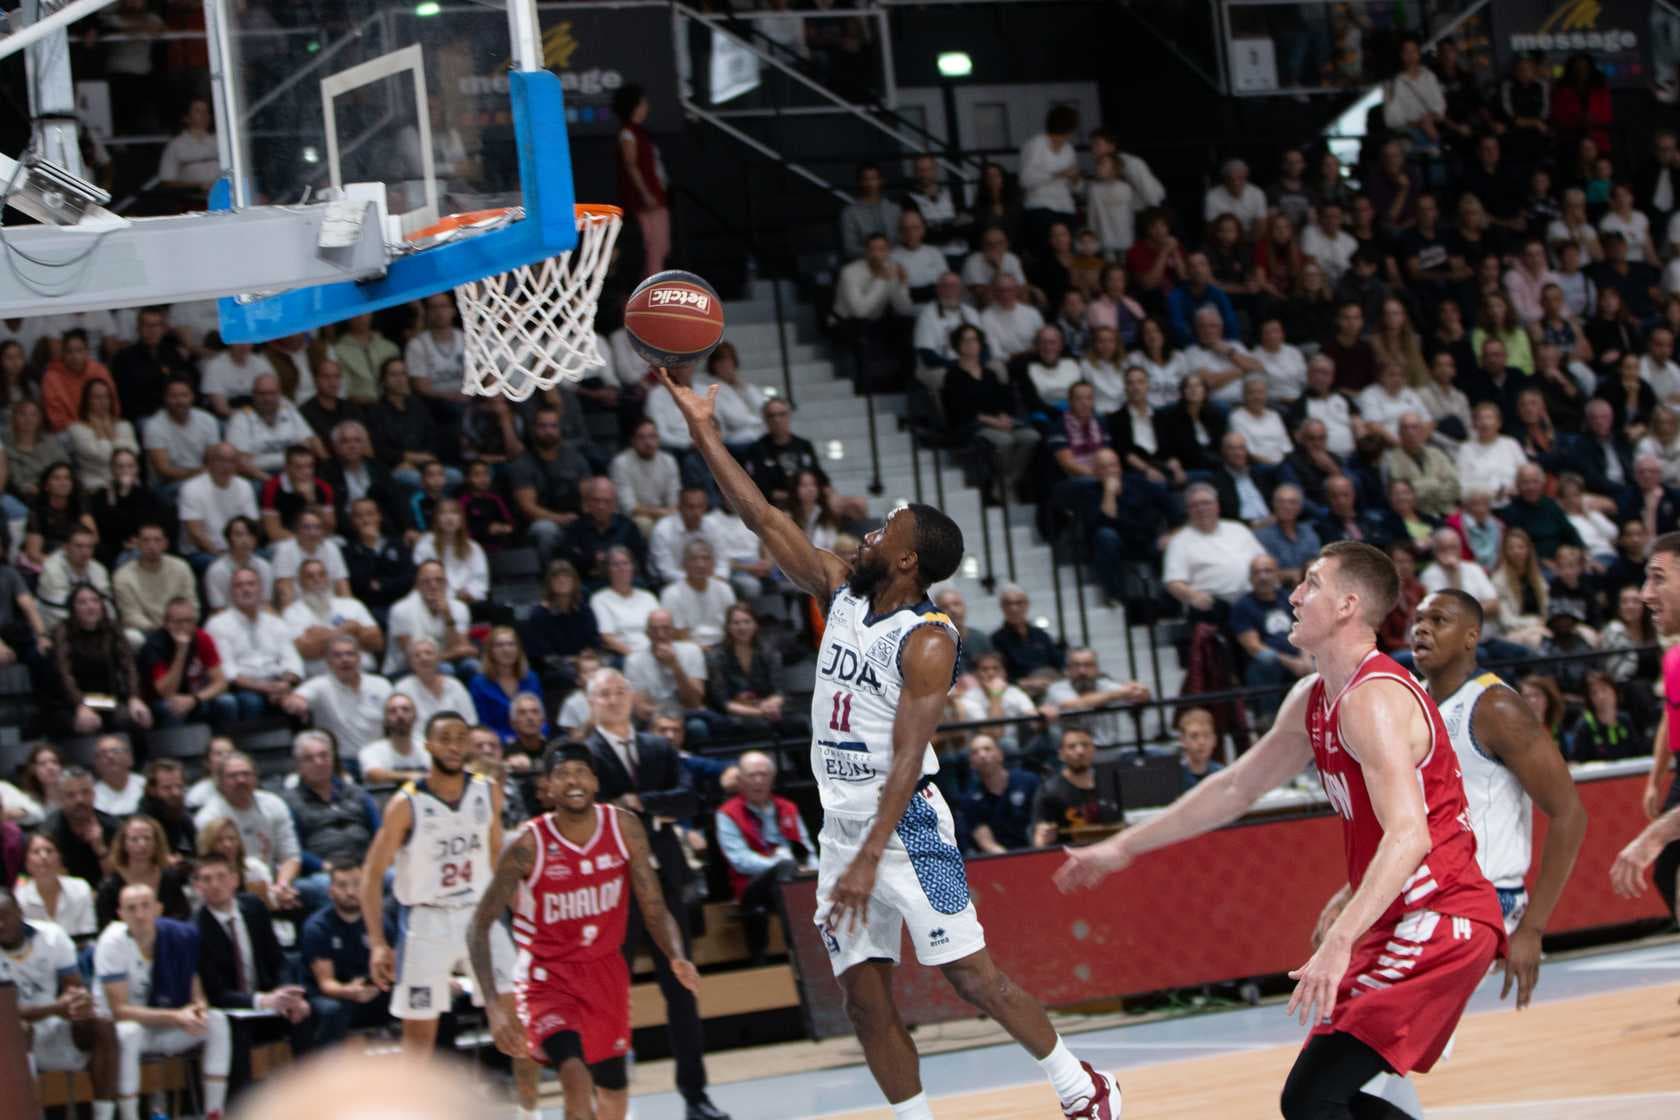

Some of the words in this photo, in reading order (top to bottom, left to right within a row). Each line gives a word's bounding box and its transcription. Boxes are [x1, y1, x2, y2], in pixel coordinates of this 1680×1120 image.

[1510, 30, 1637, 51] message
[457, 69, 622, 95] meage
[651, 290, 708, 311] Betclic
[822, 643, 882, 690] JDA
[829, 690, 854, 733] 11
[441, 860, 473, 888] 24
